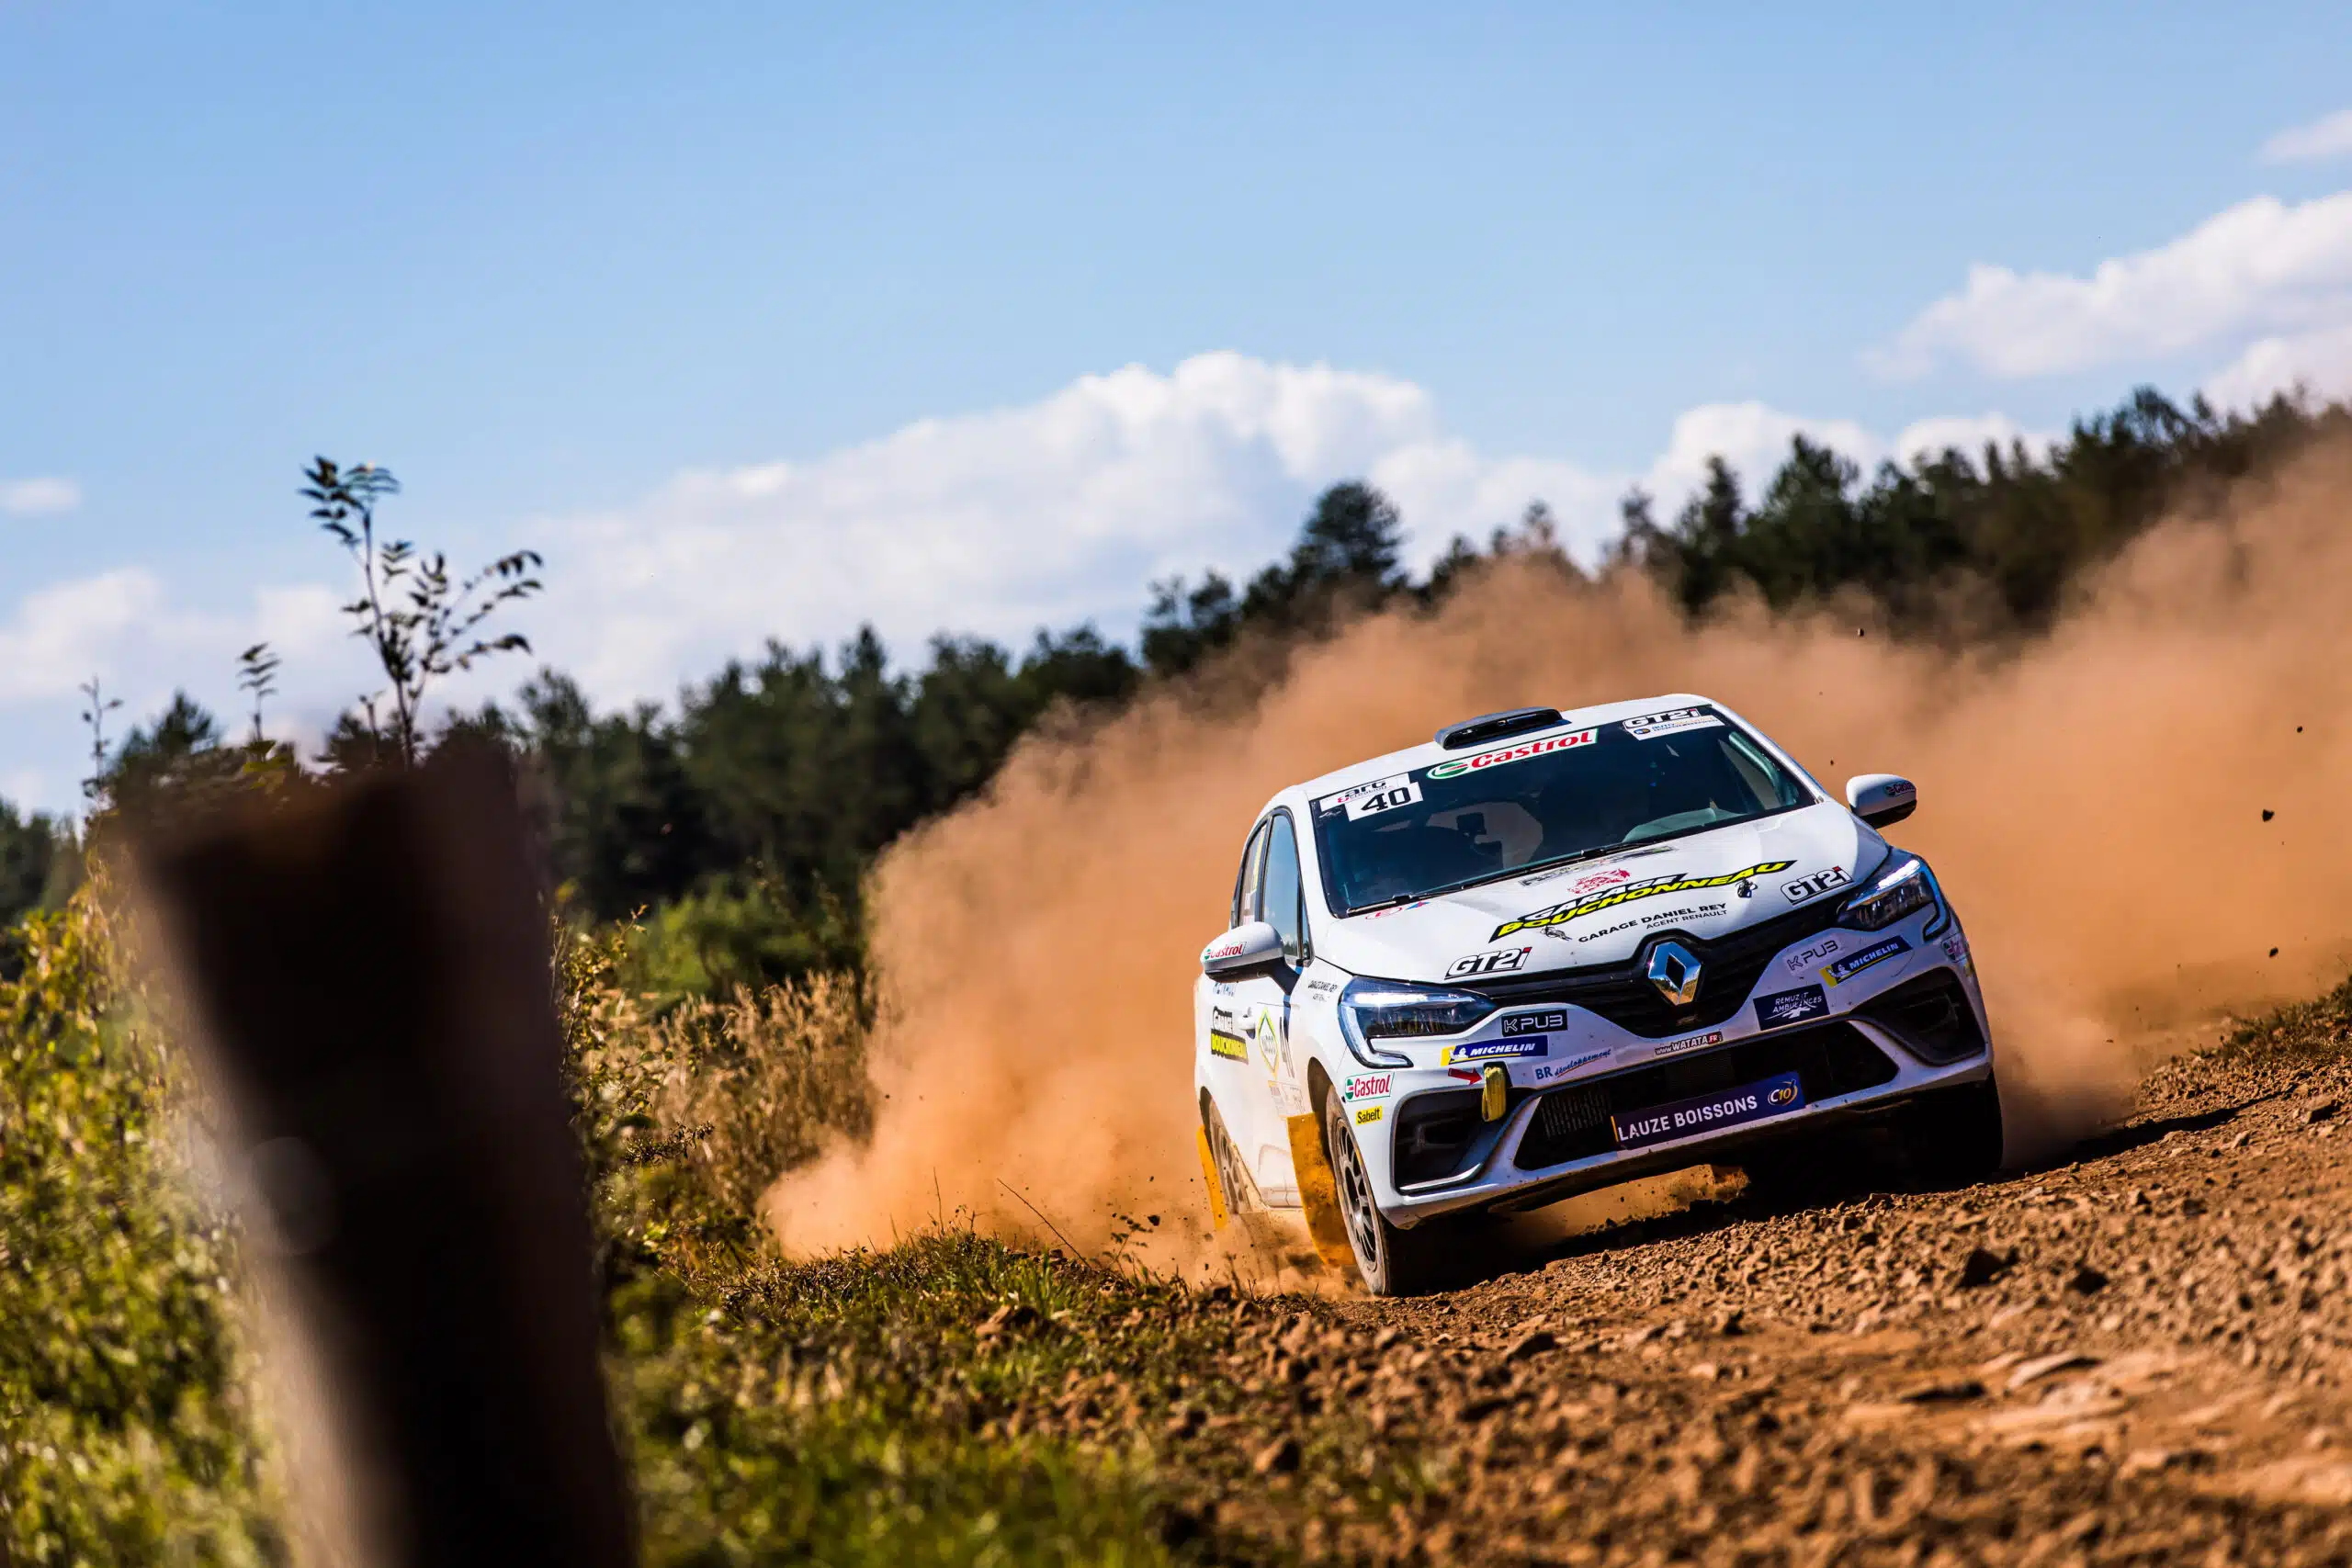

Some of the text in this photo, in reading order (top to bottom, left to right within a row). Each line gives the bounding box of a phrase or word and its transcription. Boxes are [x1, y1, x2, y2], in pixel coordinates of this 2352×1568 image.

[1623, 707, 1701, 728] GT2i
[1471, 731, 1596, 769] Castrol
[1361, 787, 1411, 812] 40
[1781, 865, 1853, 903] GT2i
[1497, 861, 1788, 937] BOUCHONNEAU
[1522, 874, 1683, 920] GARAGE
[1578, 902, 1726, 942] GARAGE DANIEL REY
[1645, 909, 1727, 930] AGENT RENAULT
[1210, 942, 1244, 960] Castrol
[1445, 947, 1532, 978] GT2i
[1849, 942, 1899, 970] MICHELIN
[1775, 992, 1809, 1006] REMUZT
[1470, 1043, 1536, 1056] MICHELIN
[1354, 1073, 1391, 1098] Castrol
[1535, 1066, 1554, 1080] BR
[1770, 1088, 1792, 1103] C10
[1357, 1107, 1381, 1123] Sabelt
[1618, 1095, 1758, 1142] LAUZE BOISSONS
